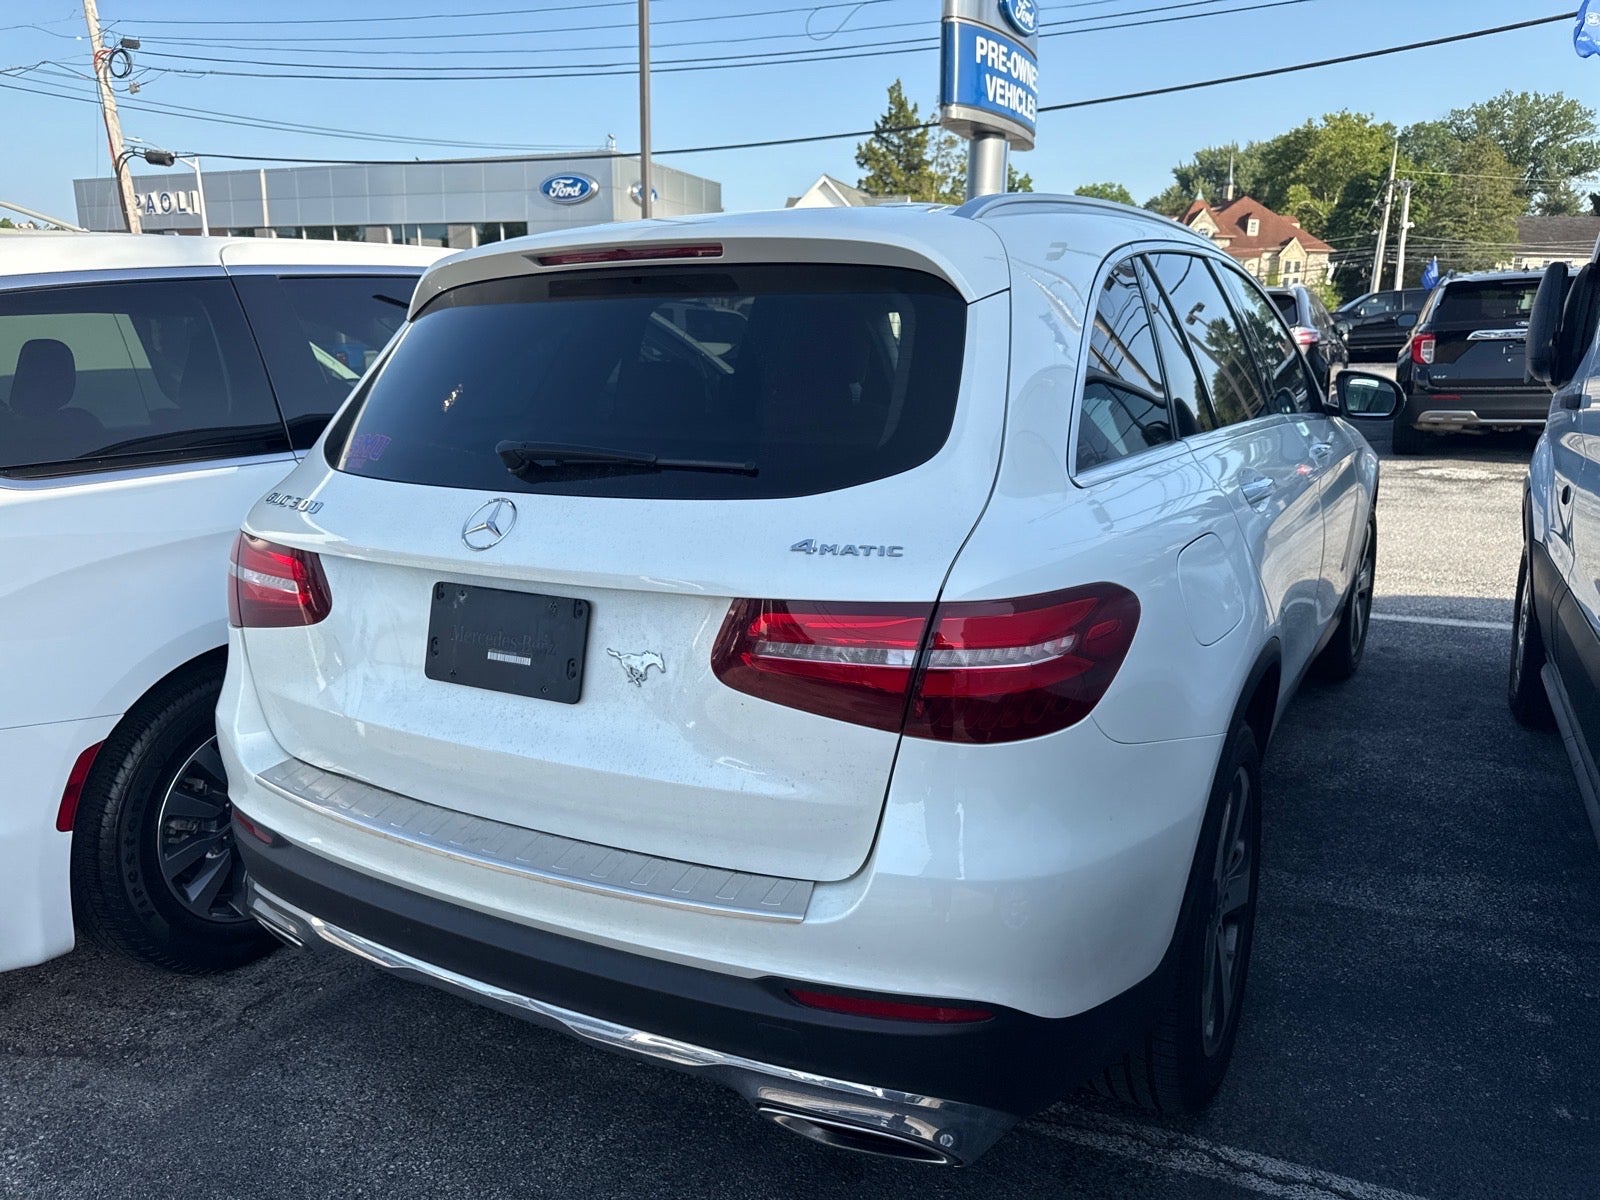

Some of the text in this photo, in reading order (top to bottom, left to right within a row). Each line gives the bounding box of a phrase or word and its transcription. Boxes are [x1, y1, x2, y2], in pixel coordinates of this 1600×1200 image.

[976, 36, 1038, 93] PRE-OWNE
[549, 179, 582, 197] Ford
[790, 539, 904, 557] 4MATIC
